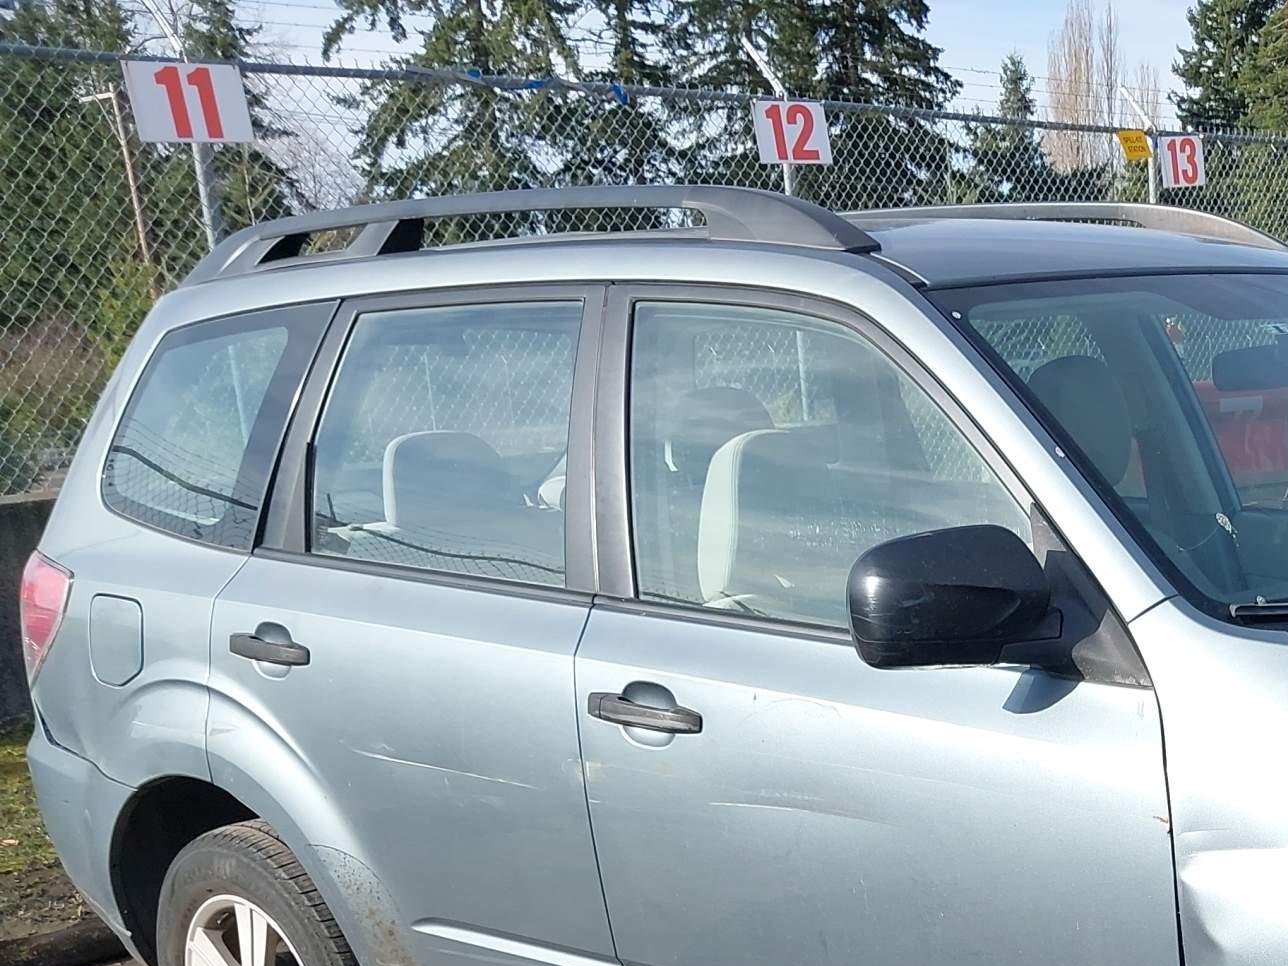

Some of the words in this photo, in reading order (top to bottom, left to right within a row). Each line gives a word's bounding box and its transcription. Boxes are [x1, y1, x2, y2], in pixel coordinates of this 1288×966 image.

[154, 66, 224, 139] 11
[765, 104, 820, 161] 12
[1167, 138, 1199, 185] 13
